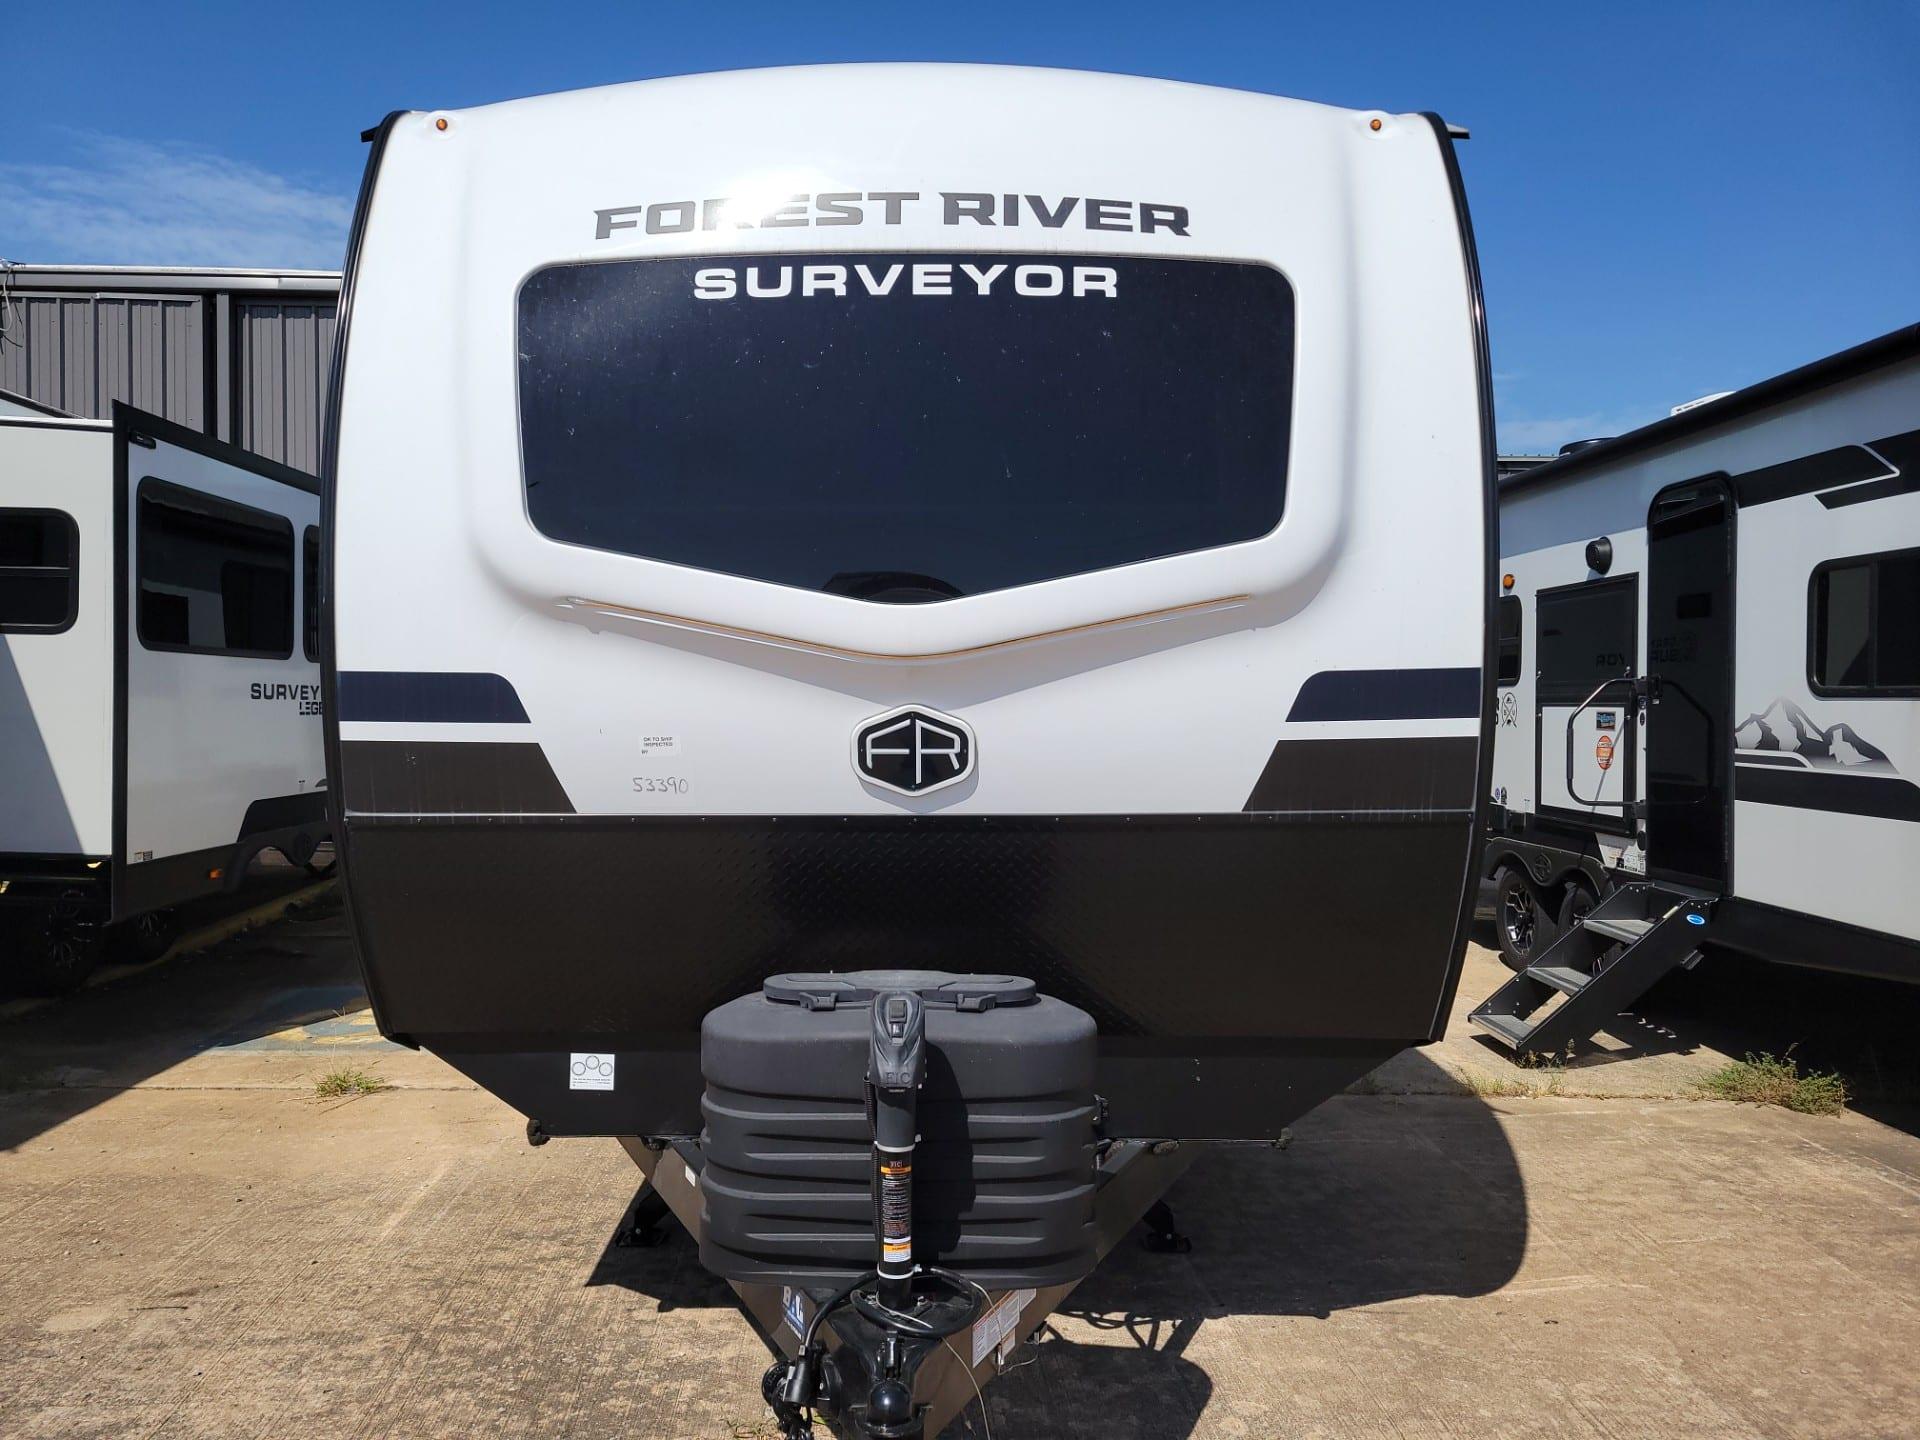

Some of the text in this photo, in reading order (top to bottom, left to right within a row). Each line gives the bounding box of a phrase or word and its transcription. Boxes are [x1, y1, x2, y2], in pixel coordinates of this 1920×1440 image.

[938, 192, 1192, 237] RIVER
[693, 263, 1118, 301] SURVEYOR
[632, 776, 689, 795] 53390
